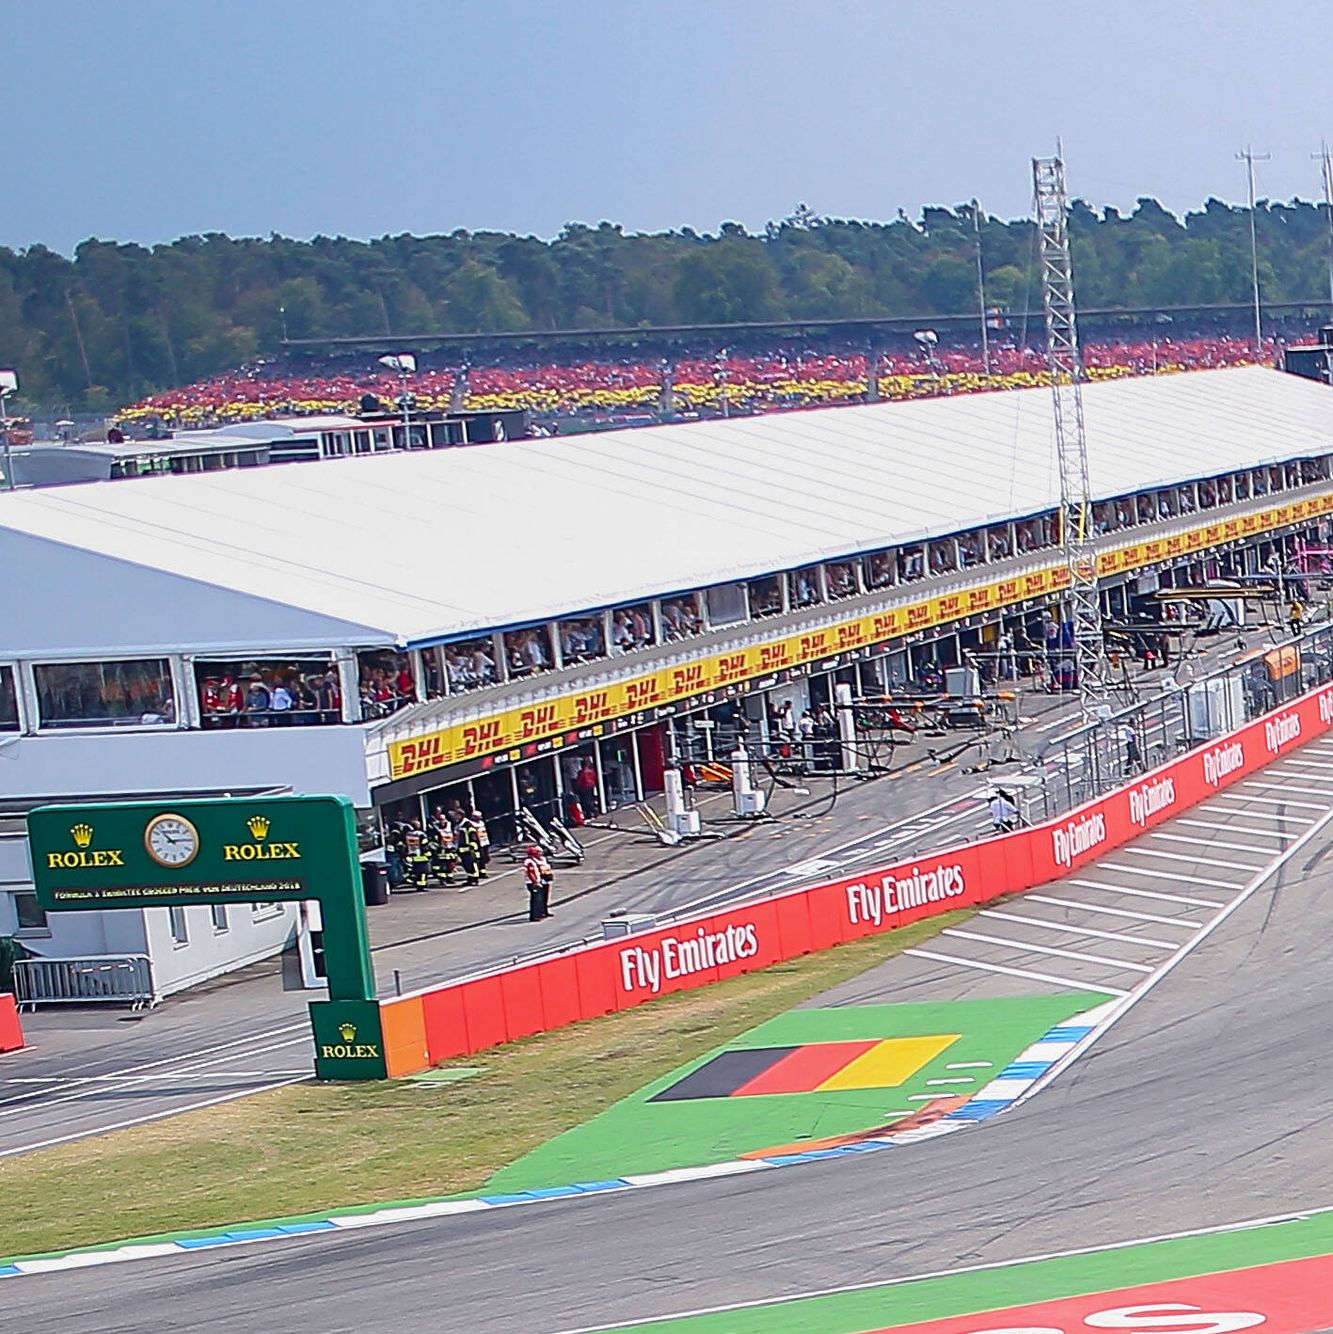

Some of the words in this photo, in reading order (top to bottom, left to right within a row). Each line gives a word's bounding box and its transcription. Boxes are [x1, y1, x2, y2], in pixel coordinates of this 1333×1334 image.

[760, 643, 787, 670] DHL
[800, 633, 826, 660] DHL
[673, 665, 704, 694] DHL
[719, 654, 748, 682] DHL
[575, 692, 611, 724] DHL
[626, 678, 660, 709] DHL
[463, 721, 505, 755] DHL
[521, 706, 560, 738] DHL
[401, 738, 446, 773] DHL
[1203, 751, 1219, 786] Fly
[1217, 740, 1244, 777] Emirates
[1128, 788, 1146, 827] Fly
[1143, 776, 1175, 816] Emirates
[224, 843, 301, 861] ROLEX
[1052, 826, 1073, 867] Fly
[1071, 812, 1106, 857] Emirates
[47, 851, 124, 869] ROLEX
[846, 883, 882, 927] Fly
[881, 864, 966, 912] Emirates
[619, 947, 660, 993] Fly
[660, 923, 758, 980] Emirates
[322, 1044, 379, 1059] ROLEX
